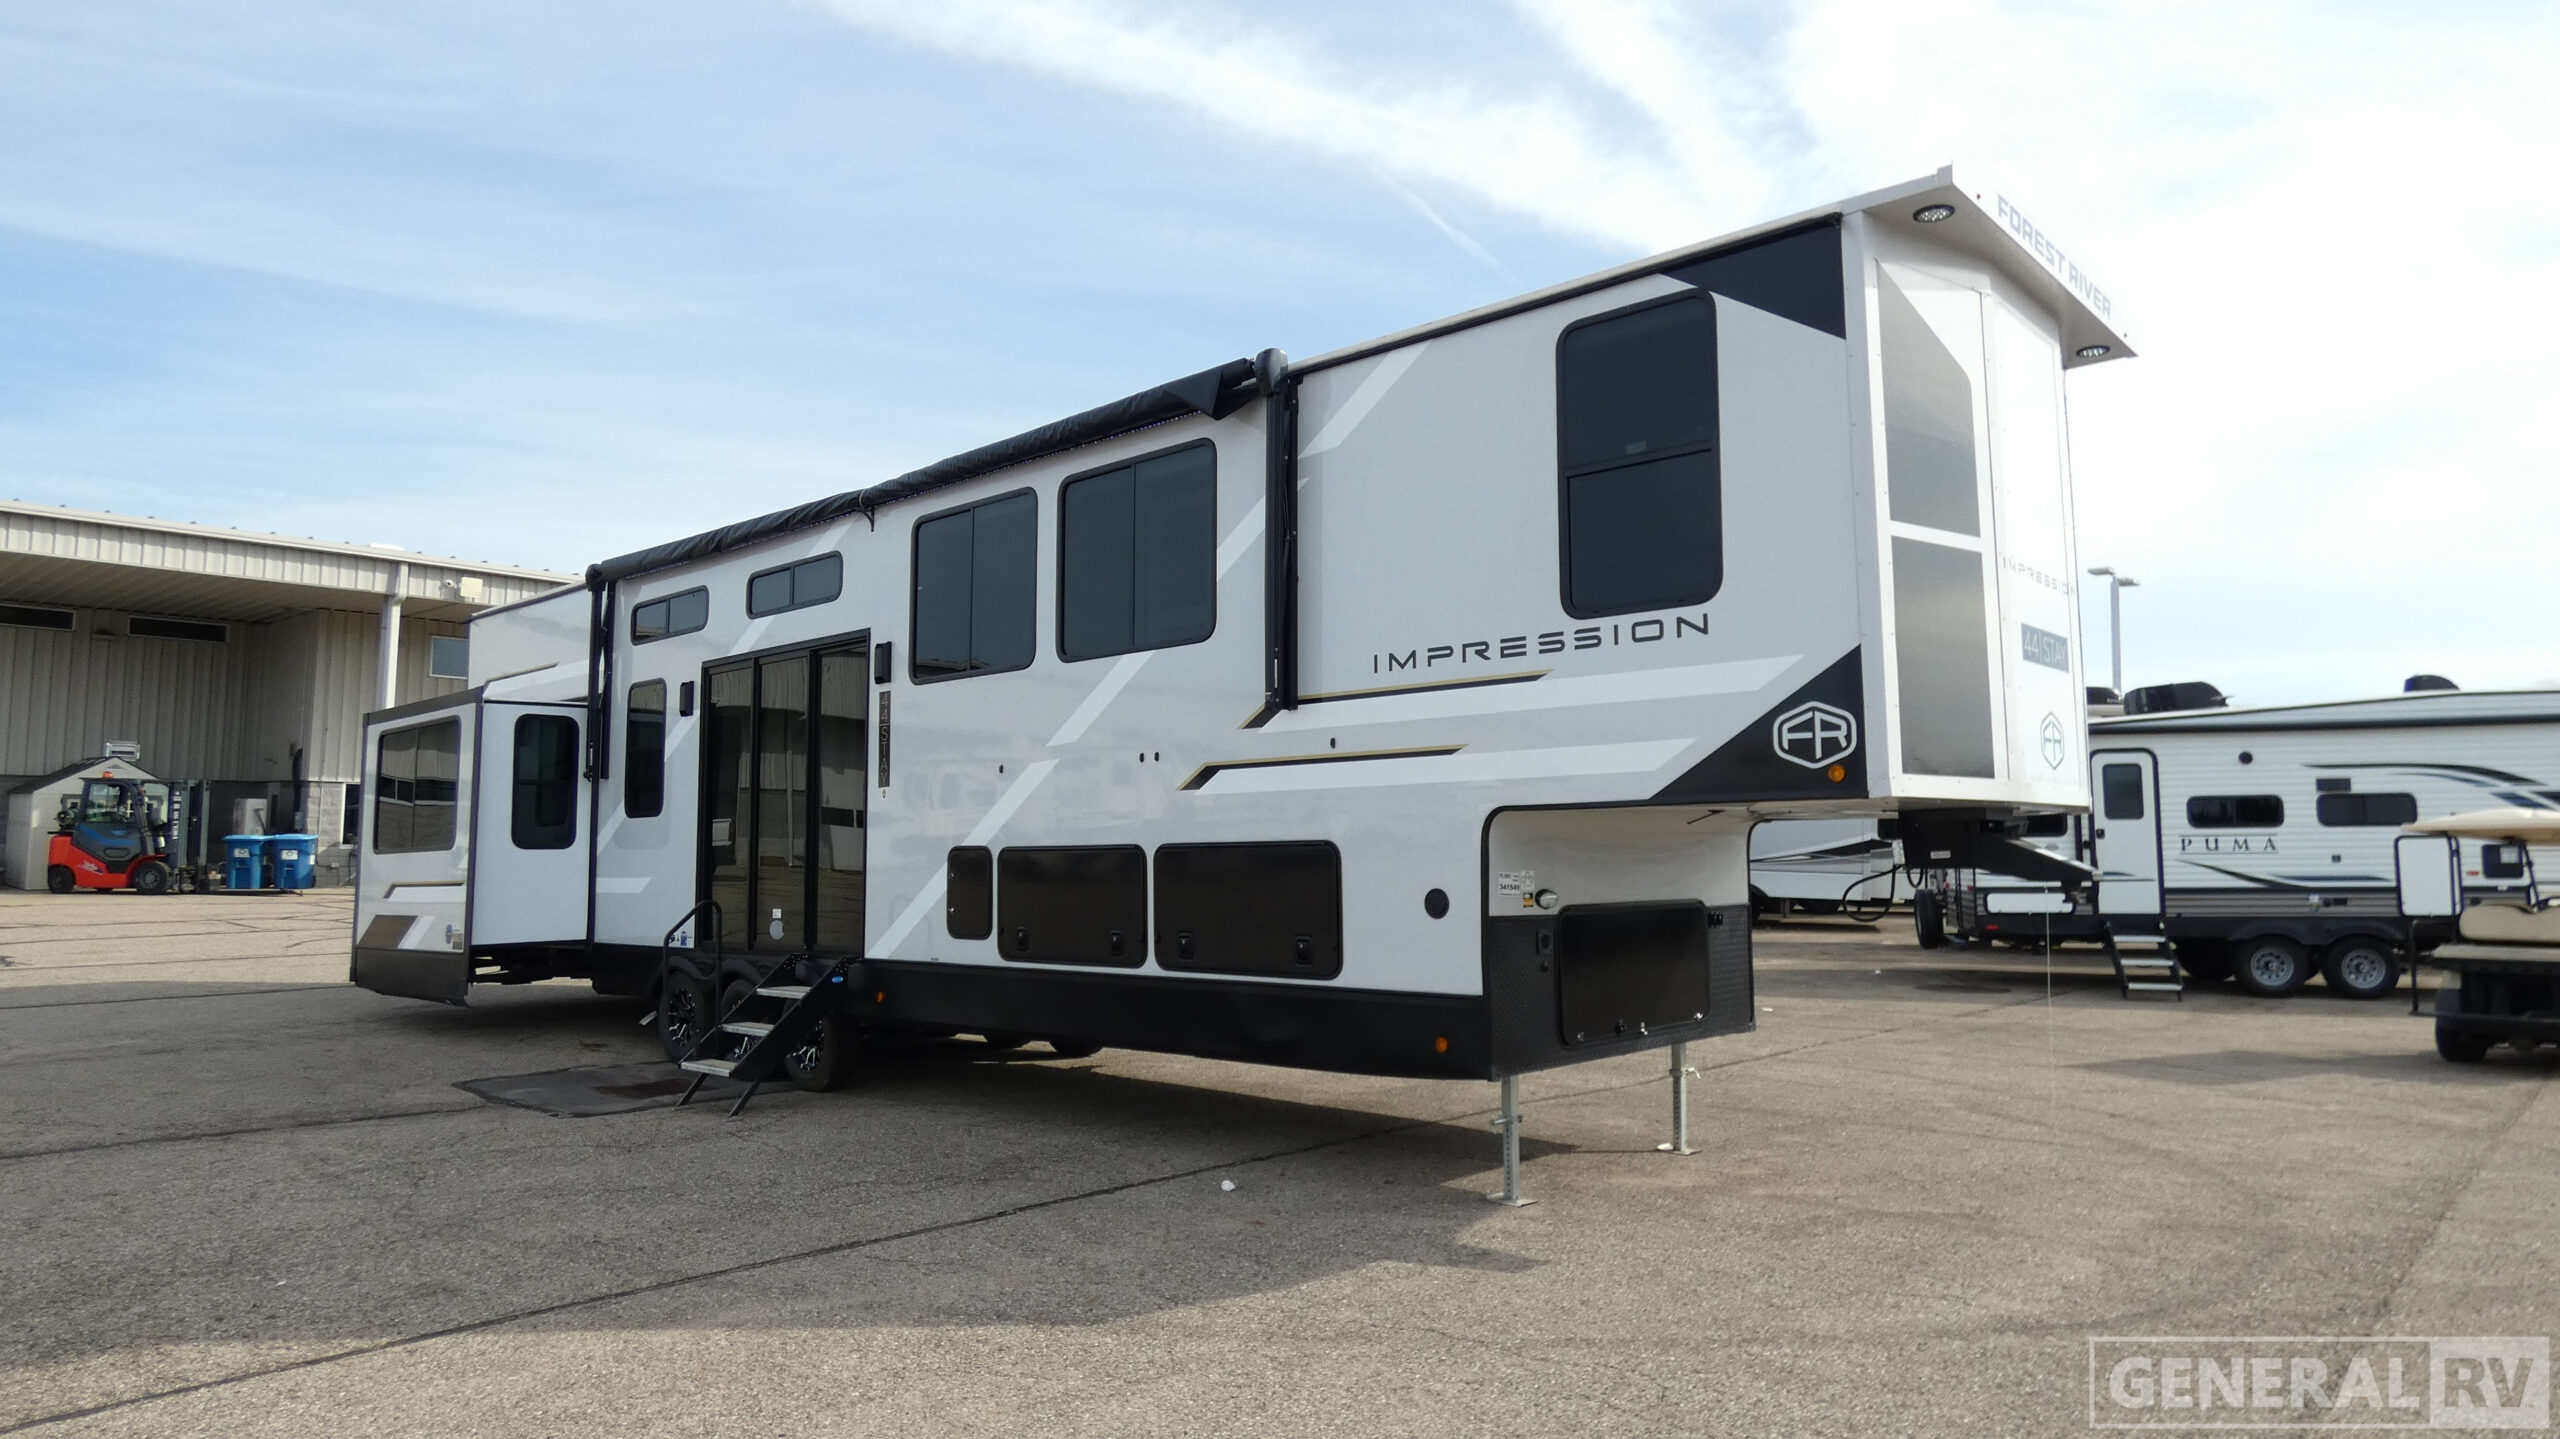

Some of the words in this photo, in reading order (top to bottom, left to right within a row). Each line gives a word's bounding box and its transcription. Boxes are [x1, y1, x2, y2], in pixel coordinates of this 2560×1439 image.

[1997, 192, 2065, 273] FOREST
[2069, 261, 2111, 320] RIVER
[1373, 613, 1709, 674] IMPRESSION
[2181, 838, 2276, 851] PUMA
